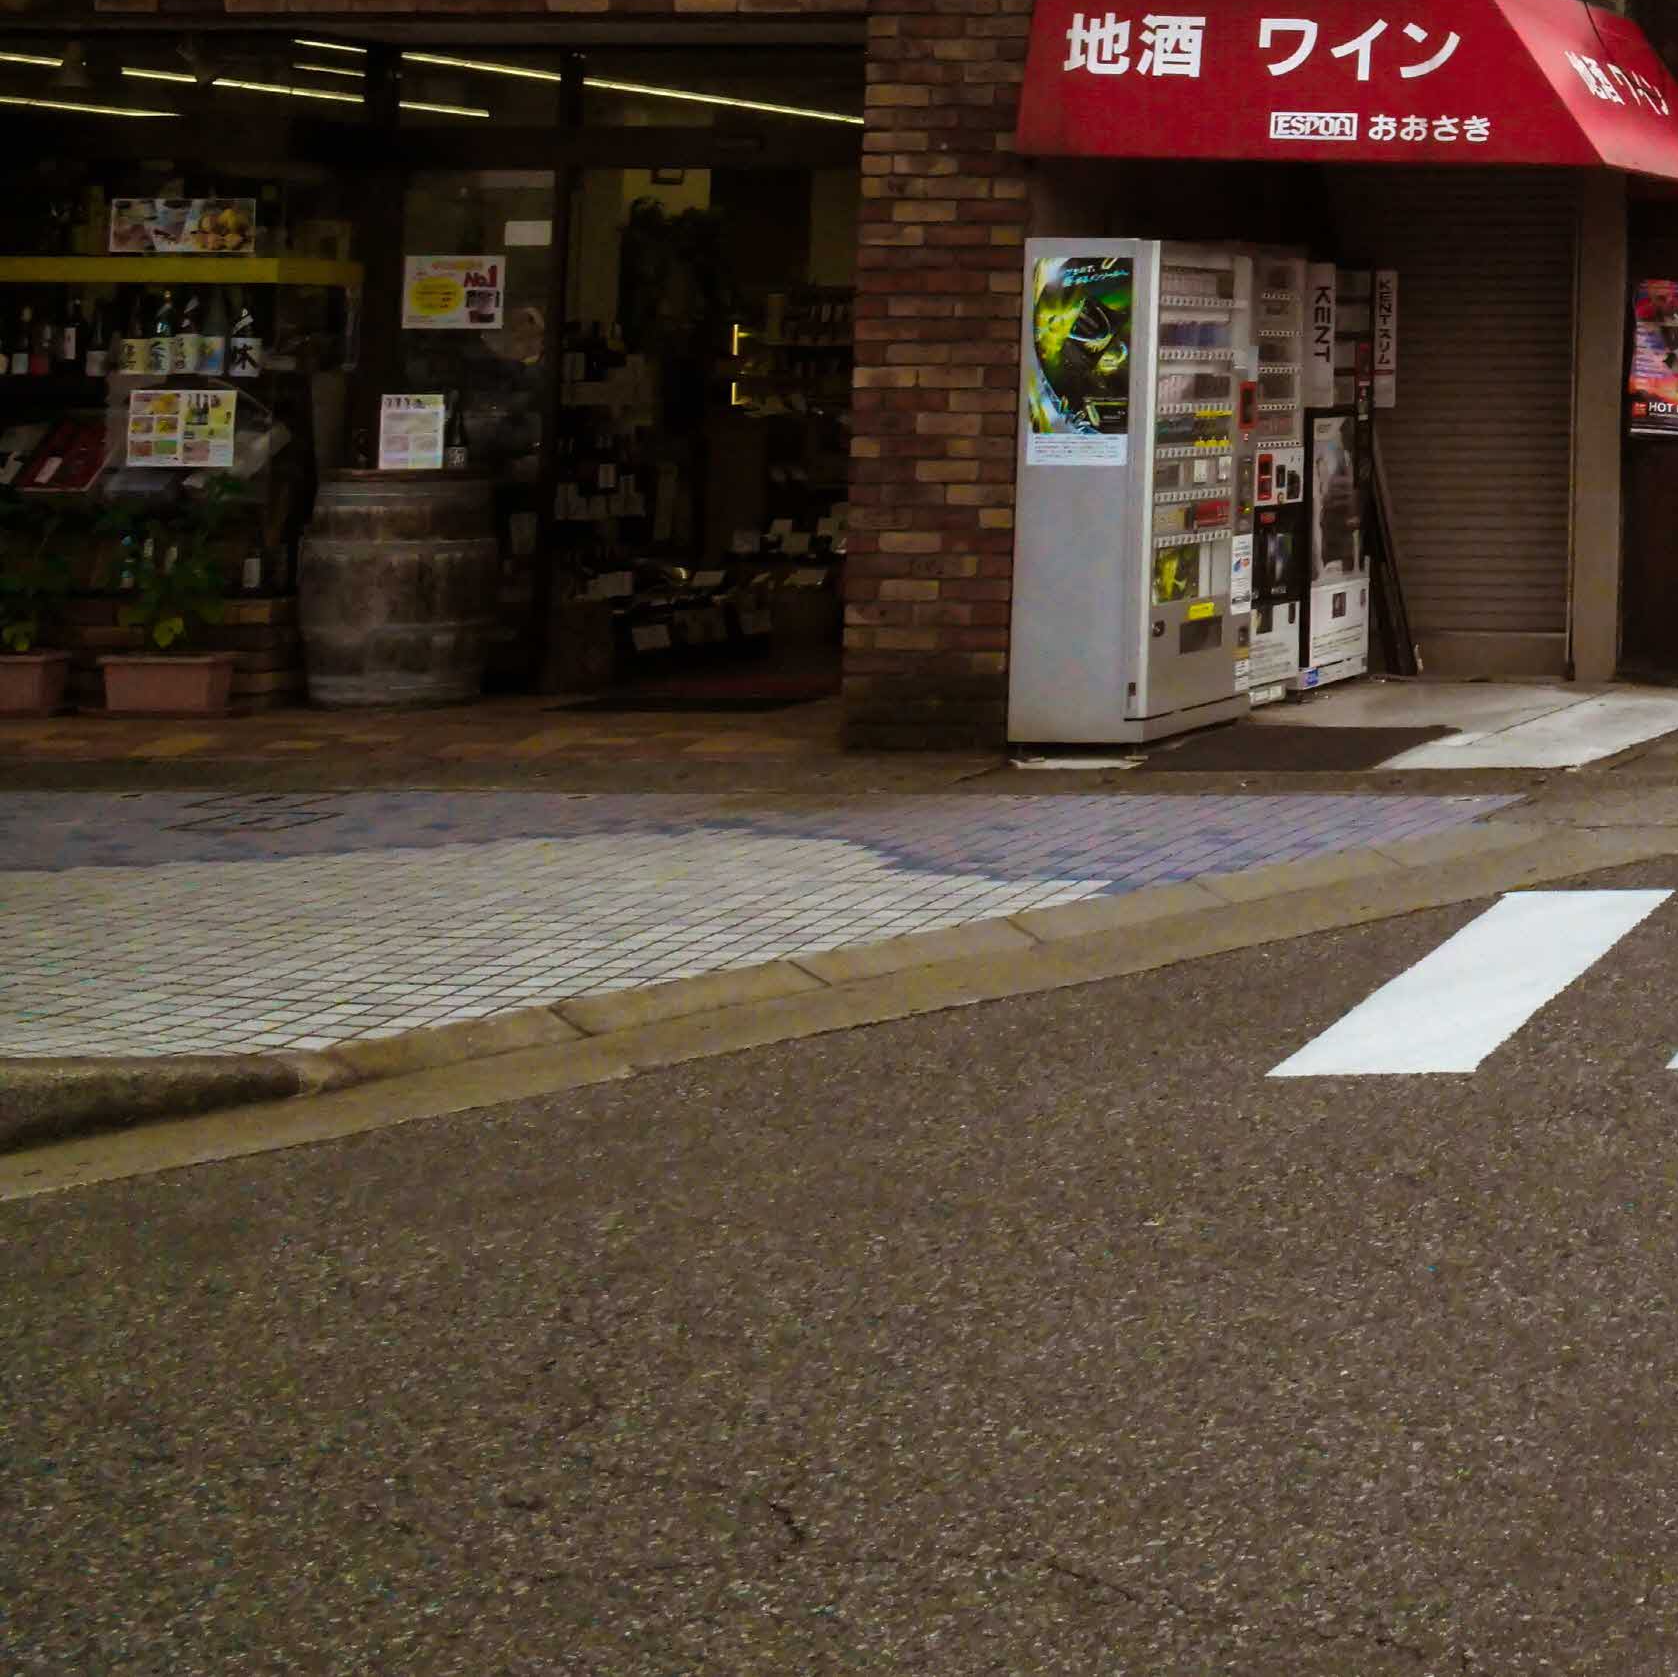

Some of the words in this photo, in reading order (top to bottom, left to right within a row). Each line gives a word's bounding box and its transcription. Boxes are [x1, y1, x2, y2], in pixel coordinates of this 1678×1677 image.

[1064, 12, 1206, 78] 地酒
[1259, 19, 1461, 81] ワイン
[1275, 114, 1353, 137] ESPOA
[1368, 114, 1491, 142] おおさき
[1314, 286, 1331, 363] KENT
[1649, 402, 1673, 413] HOT
